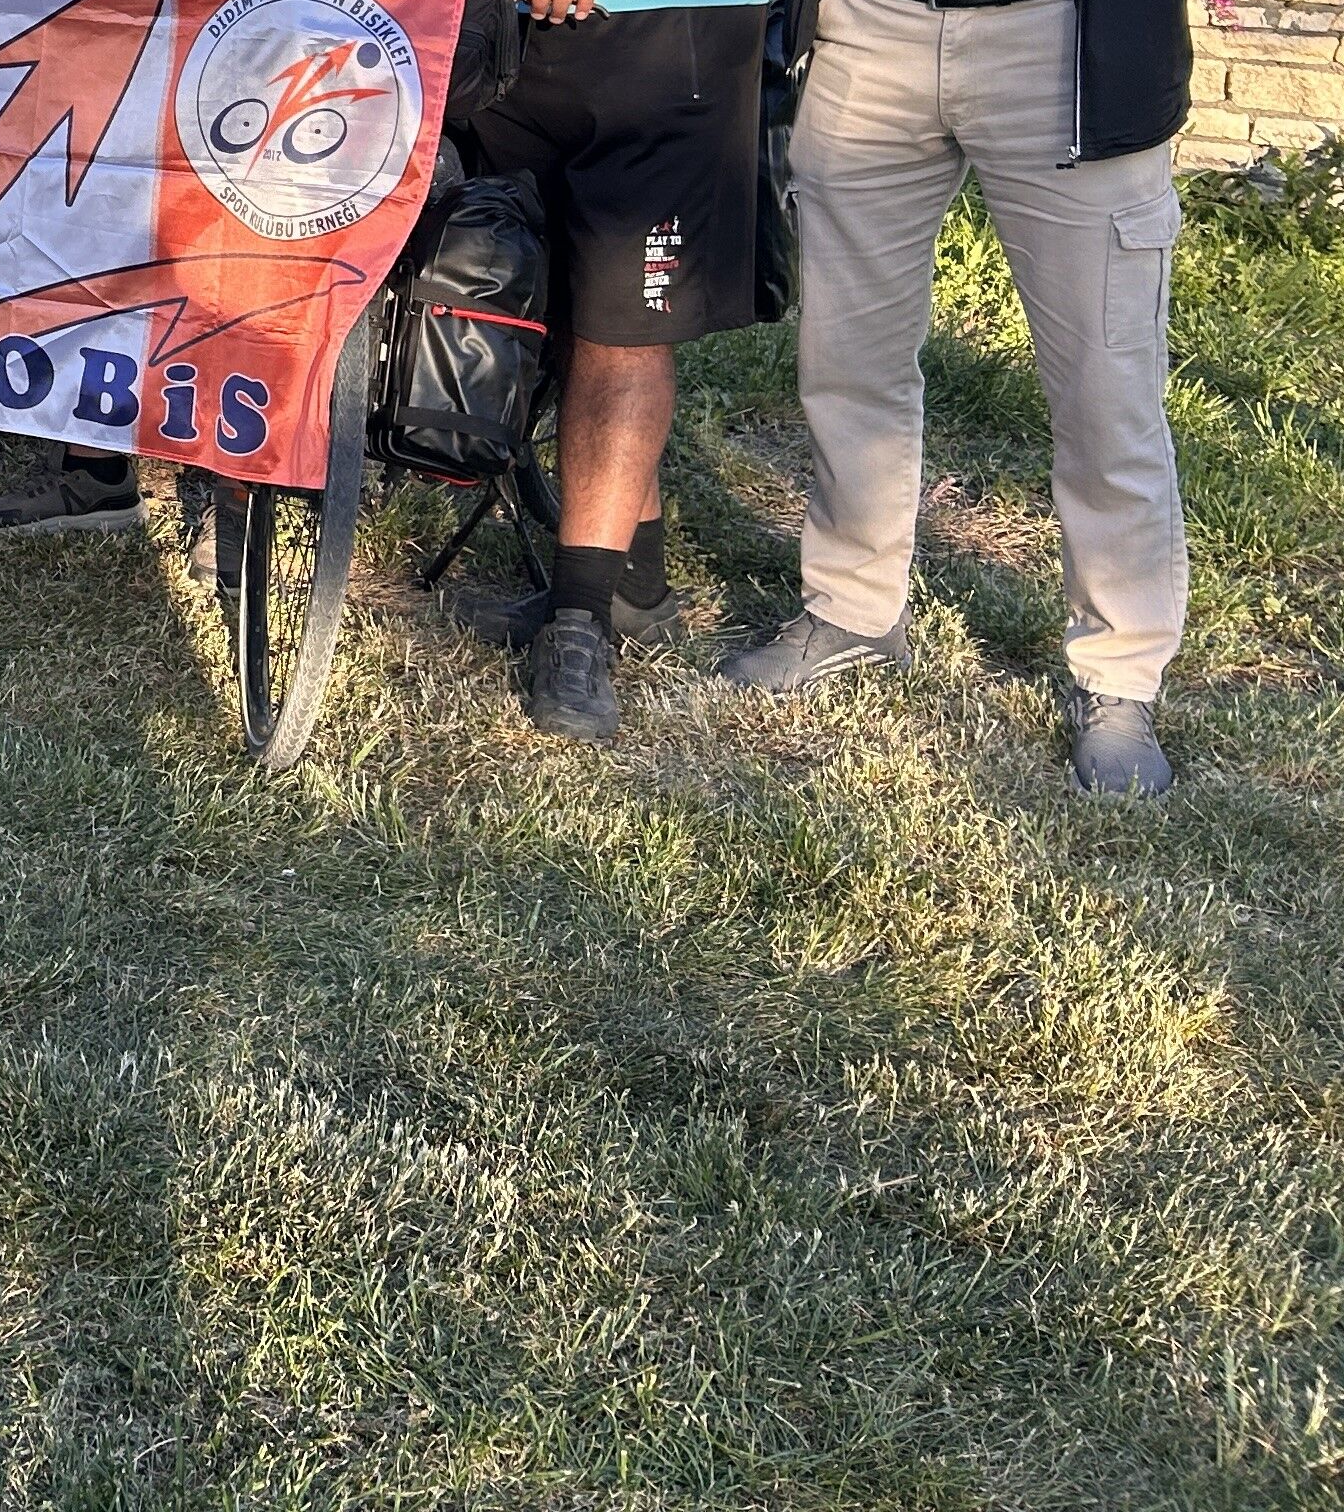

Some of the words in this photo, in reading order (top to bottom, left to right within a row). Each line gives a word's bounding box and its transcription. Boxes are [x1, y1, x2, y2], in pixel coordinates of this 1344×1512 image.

[219, 187, 249, 217] SPOR
[249, 210, 294, 238] KULÜBÜ
[299, 201, 362, 237] DERNEĞİ
[646, 236, 668, 246] PLAY
